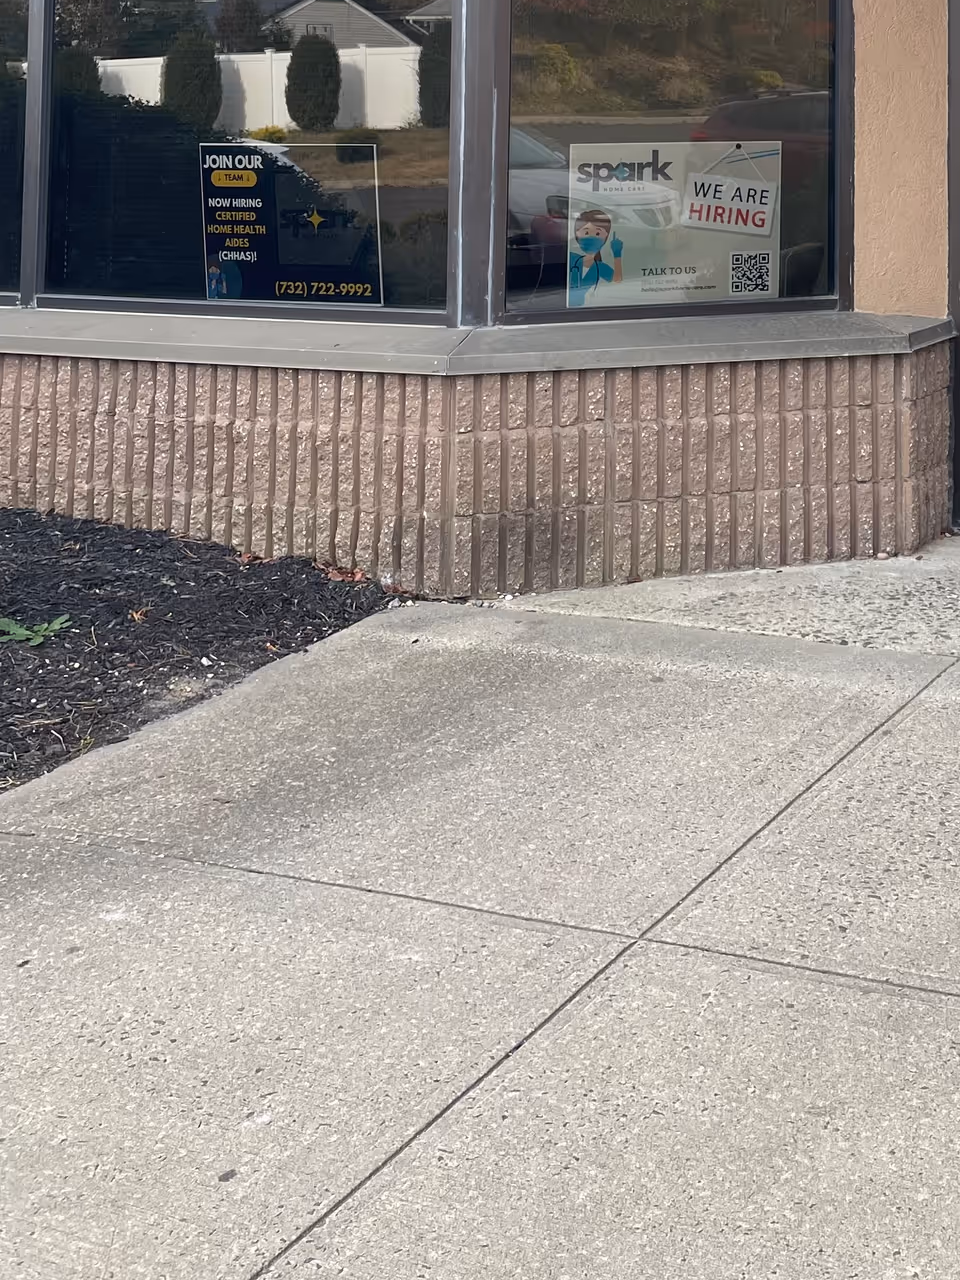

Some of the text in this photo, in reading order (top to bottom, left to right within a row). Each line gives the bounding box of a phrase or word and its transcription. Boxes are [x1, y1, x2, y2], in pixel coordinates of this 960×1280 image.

[203, 155, 264, 169] JOIN OUR
[576, 149, 673, 192] spark
[224, 173, 244, 182] TEAM
[694, 181, 769, 206] WE ARE
[208, 198, 263, 208] NOW HIRING
[215, 211, 257, 221] CERTIFIED
[688, 202, 766, 228] HIRING
[207, 224, 266, 234] HOME HEALTH
[224, 238, 250, 248] AIDES
[218, 251, 257, 263] (CHHAS)!
[641, 266, 697, 276] TALK TO US
[275, 281, 373, 297] (732) 722-9992
